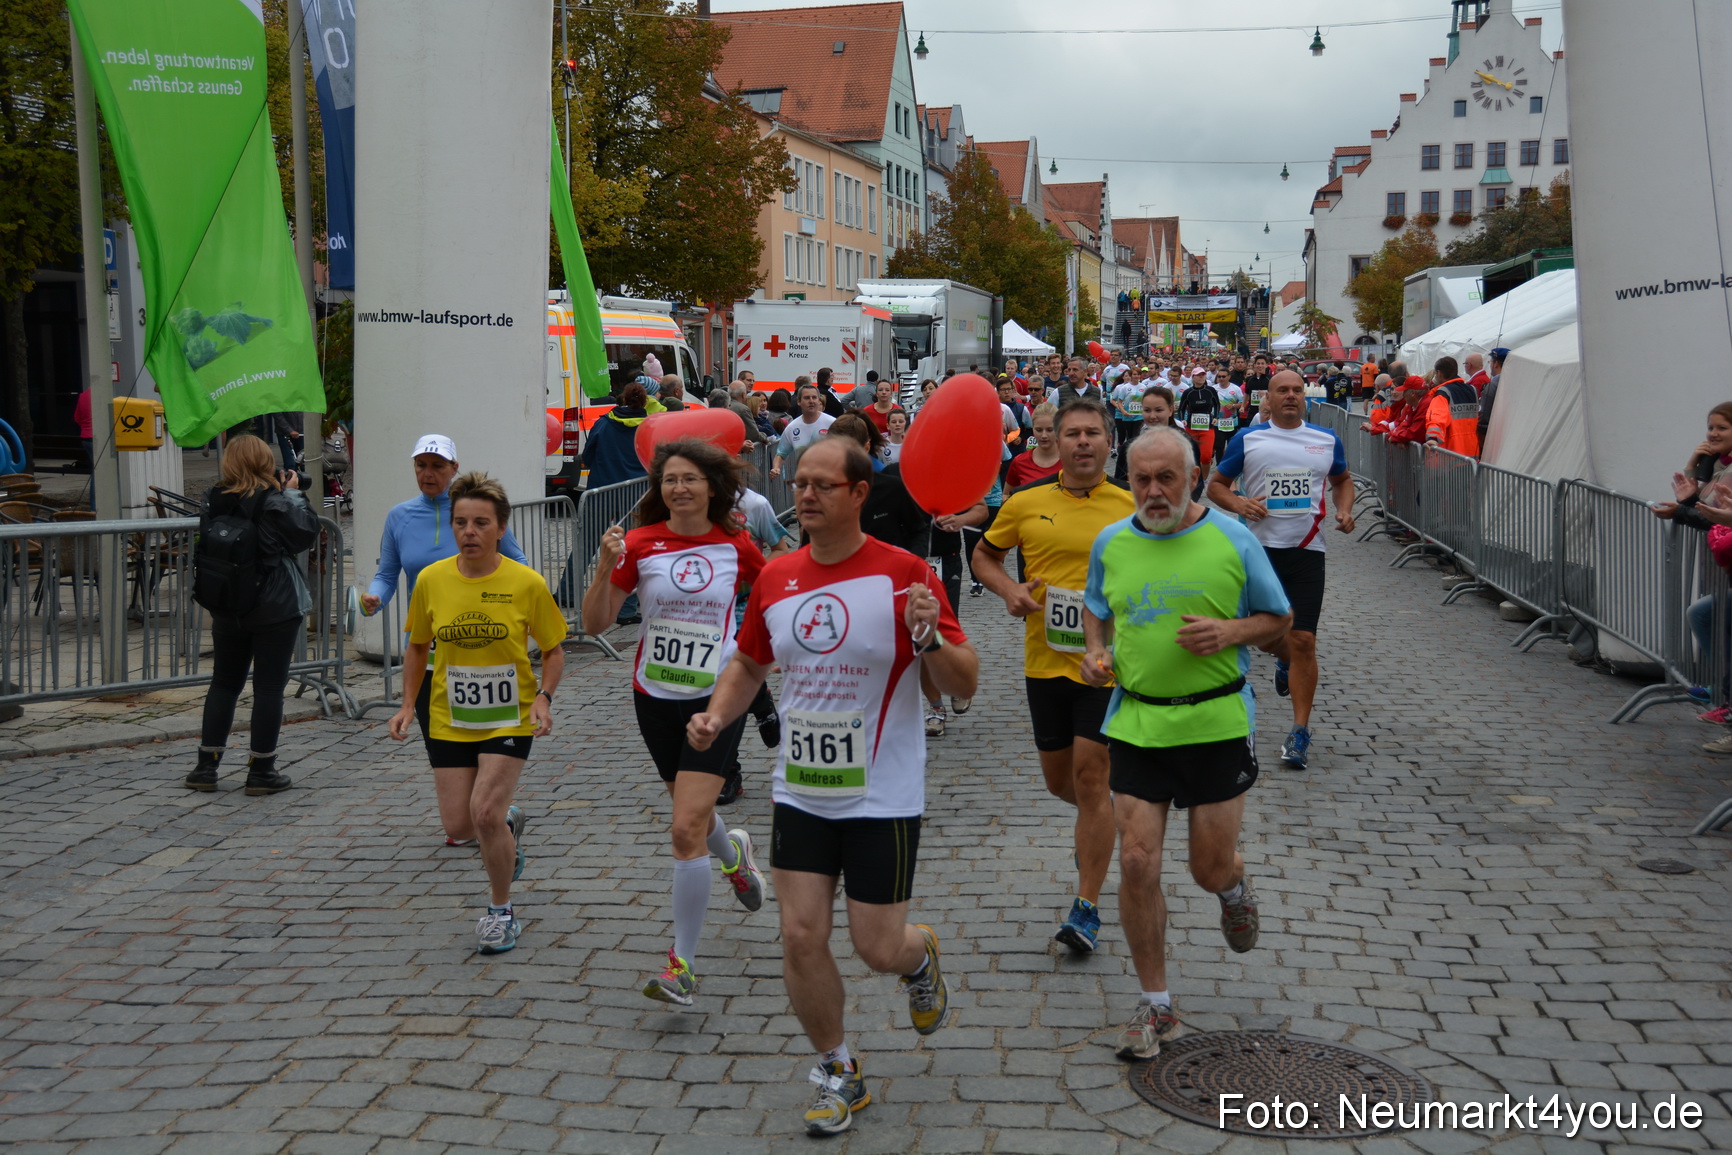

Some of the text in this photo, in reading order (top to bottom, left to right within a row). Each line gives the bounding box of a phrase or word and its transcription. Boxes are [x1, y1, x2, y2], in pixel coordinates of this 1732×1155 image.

[357, 308, 514, 328] www.bmw-laufsport.de
[1176, 313, 1207, 321] START
[789, 335, 831, 343] Bayerisches
[1192, 417, 1209, 425] 5003
[1270, 479, 1310, 497] 2535
[1284, 500, 1298, 508] Karl
[1047, 591, 1069, 602] PARTL
[706, 600, 726, 609] HERZ
[443, 624, 501, 640] FRANCESCO
[649, 624, 710, 640] PARTL Neumarkt
[653, 635, 715, 668] 5017
[447, 669, 506, 679] PARTL Neumarkt
[660, 668, 696, 685] Claudia
[815, 665, 835, 675] MIT
[839, 664, 870, 676] HERZ
[454, 680, 513, 706] 5310
[787, 715, 848, 729] PARTL Neumarkt
[791, 729, 854, 765] 5161
[799, 769, 844, 785] Andreas
